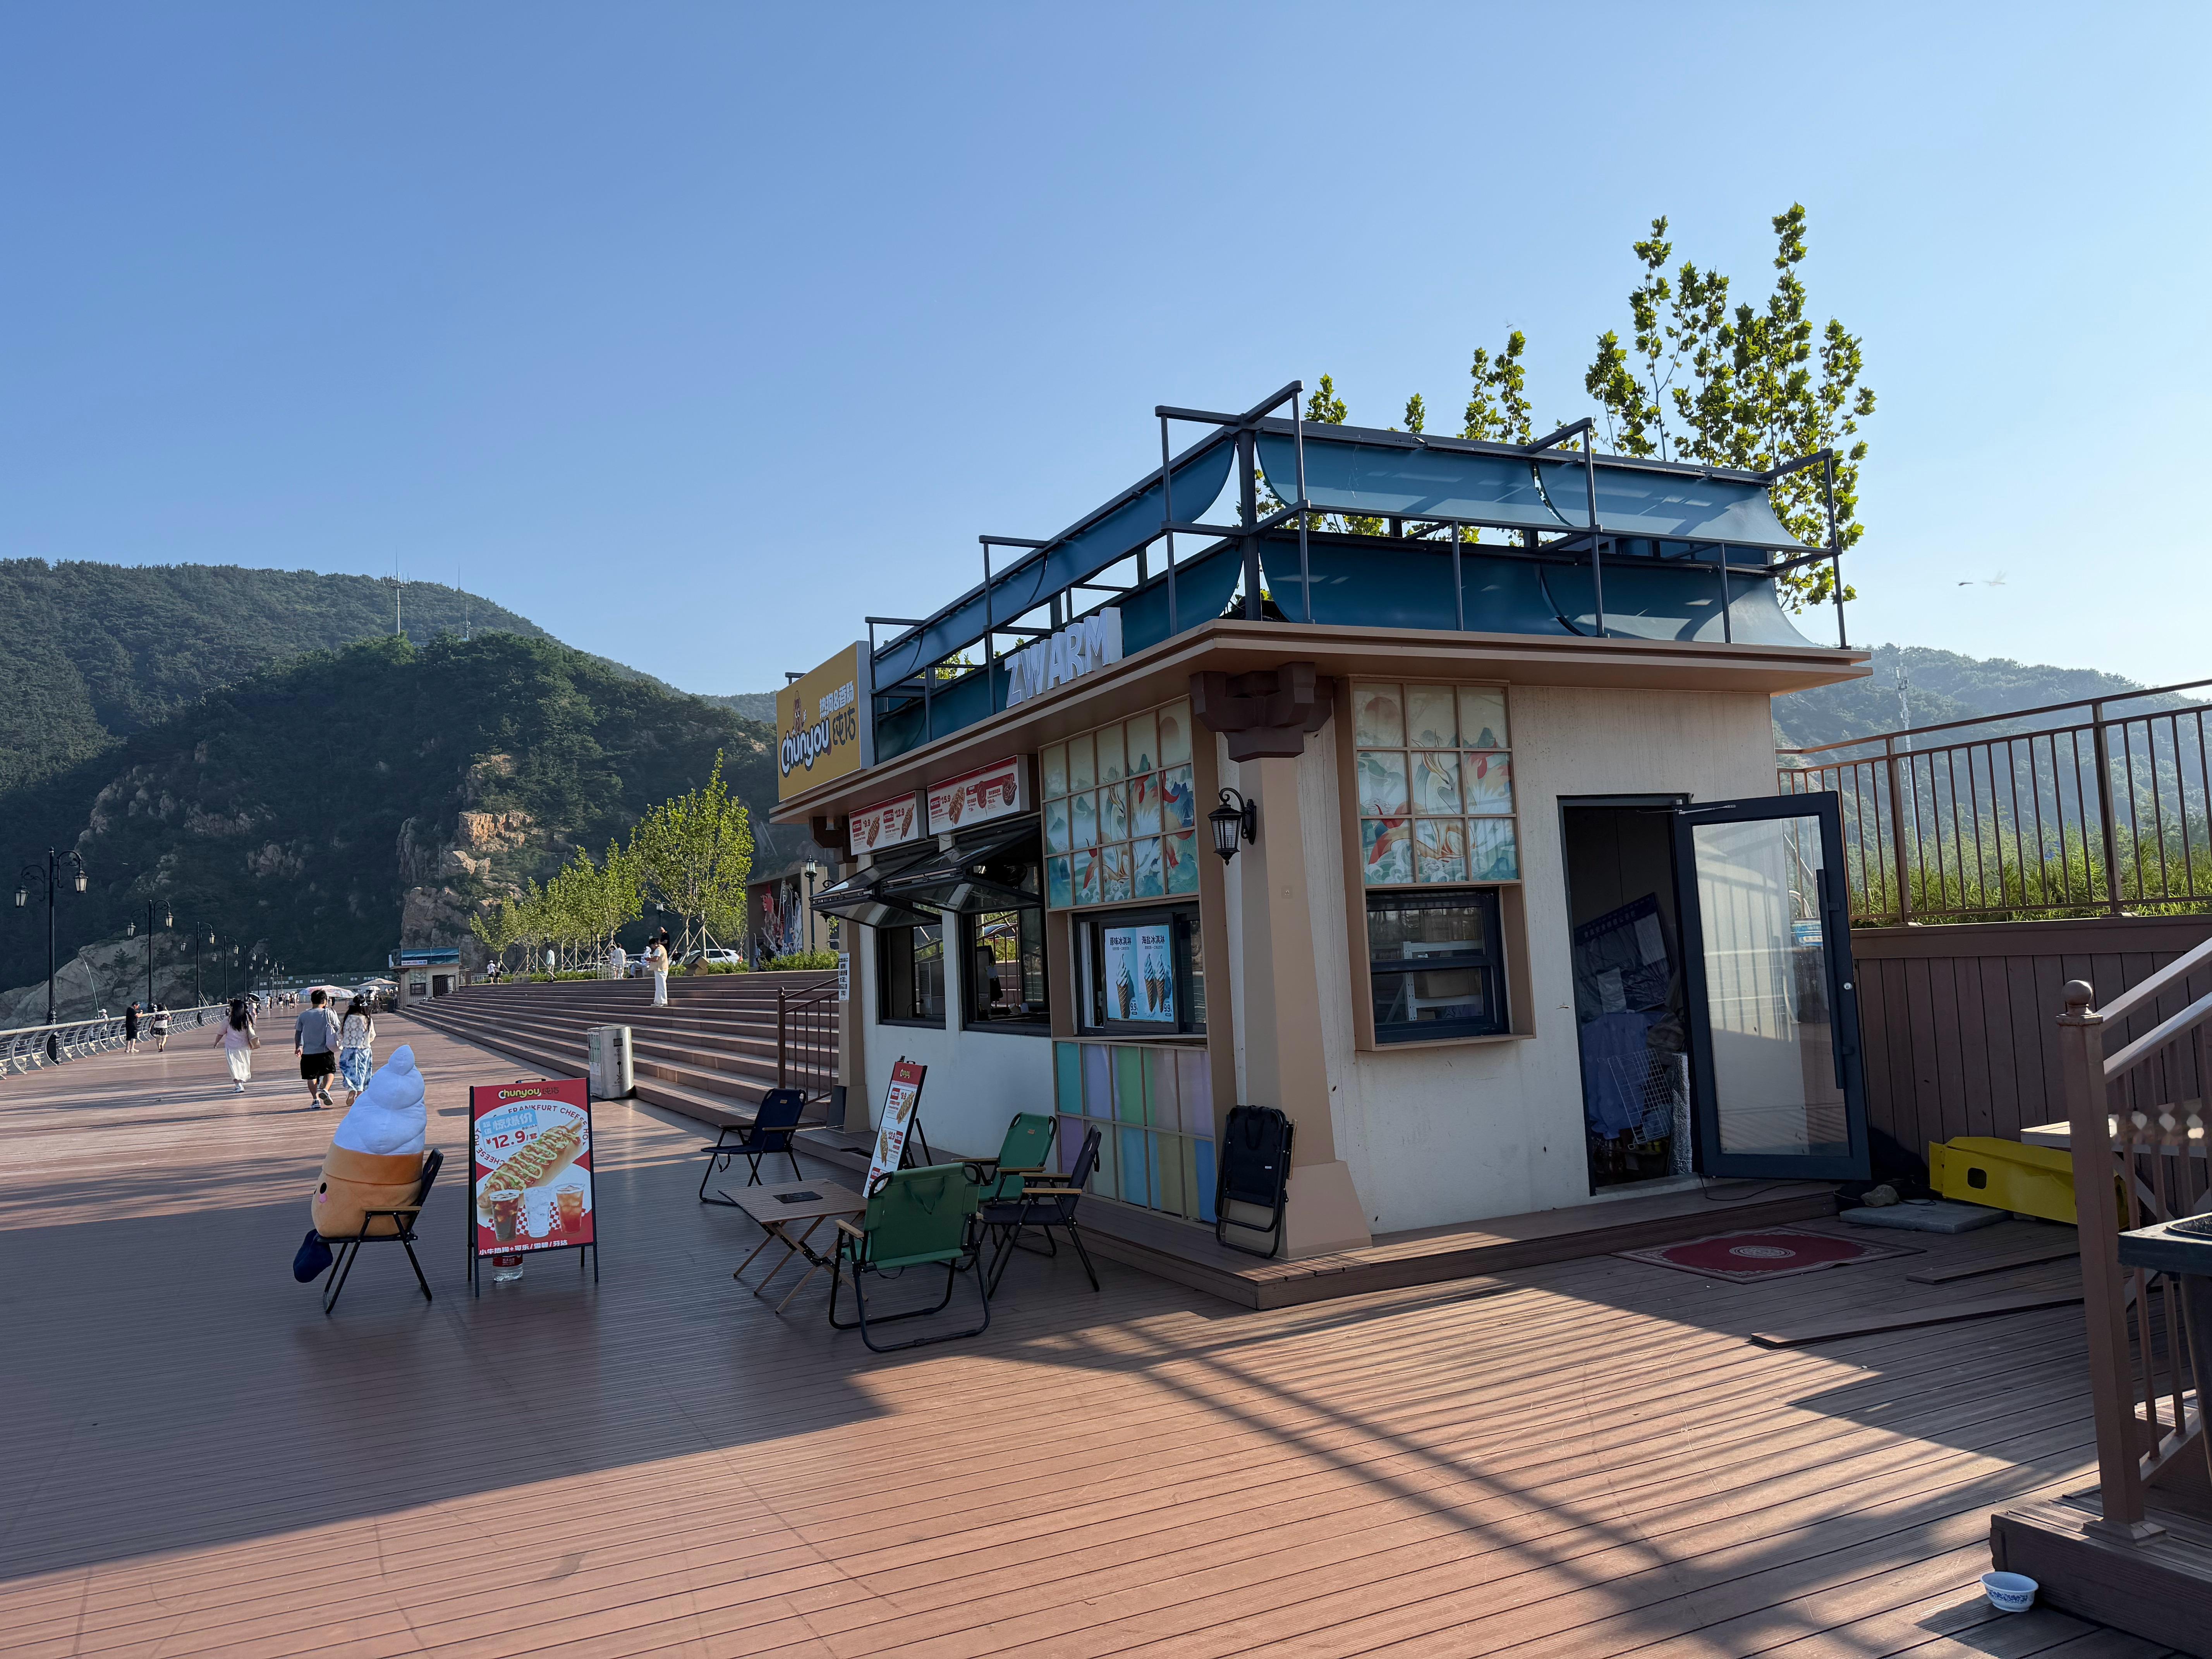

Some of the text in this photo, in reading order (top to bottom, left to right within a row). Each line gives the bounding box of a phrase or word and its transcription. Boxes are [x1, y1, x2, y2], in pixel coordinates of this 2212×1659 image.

[1005, 607, 1121, 708] ZWARM
[819, 680, 854, 719] 热狗&香肠
[493, 1112, 533, 1131] 惊爆价
[508, 1104, 558, 1113] FRANKFURT
